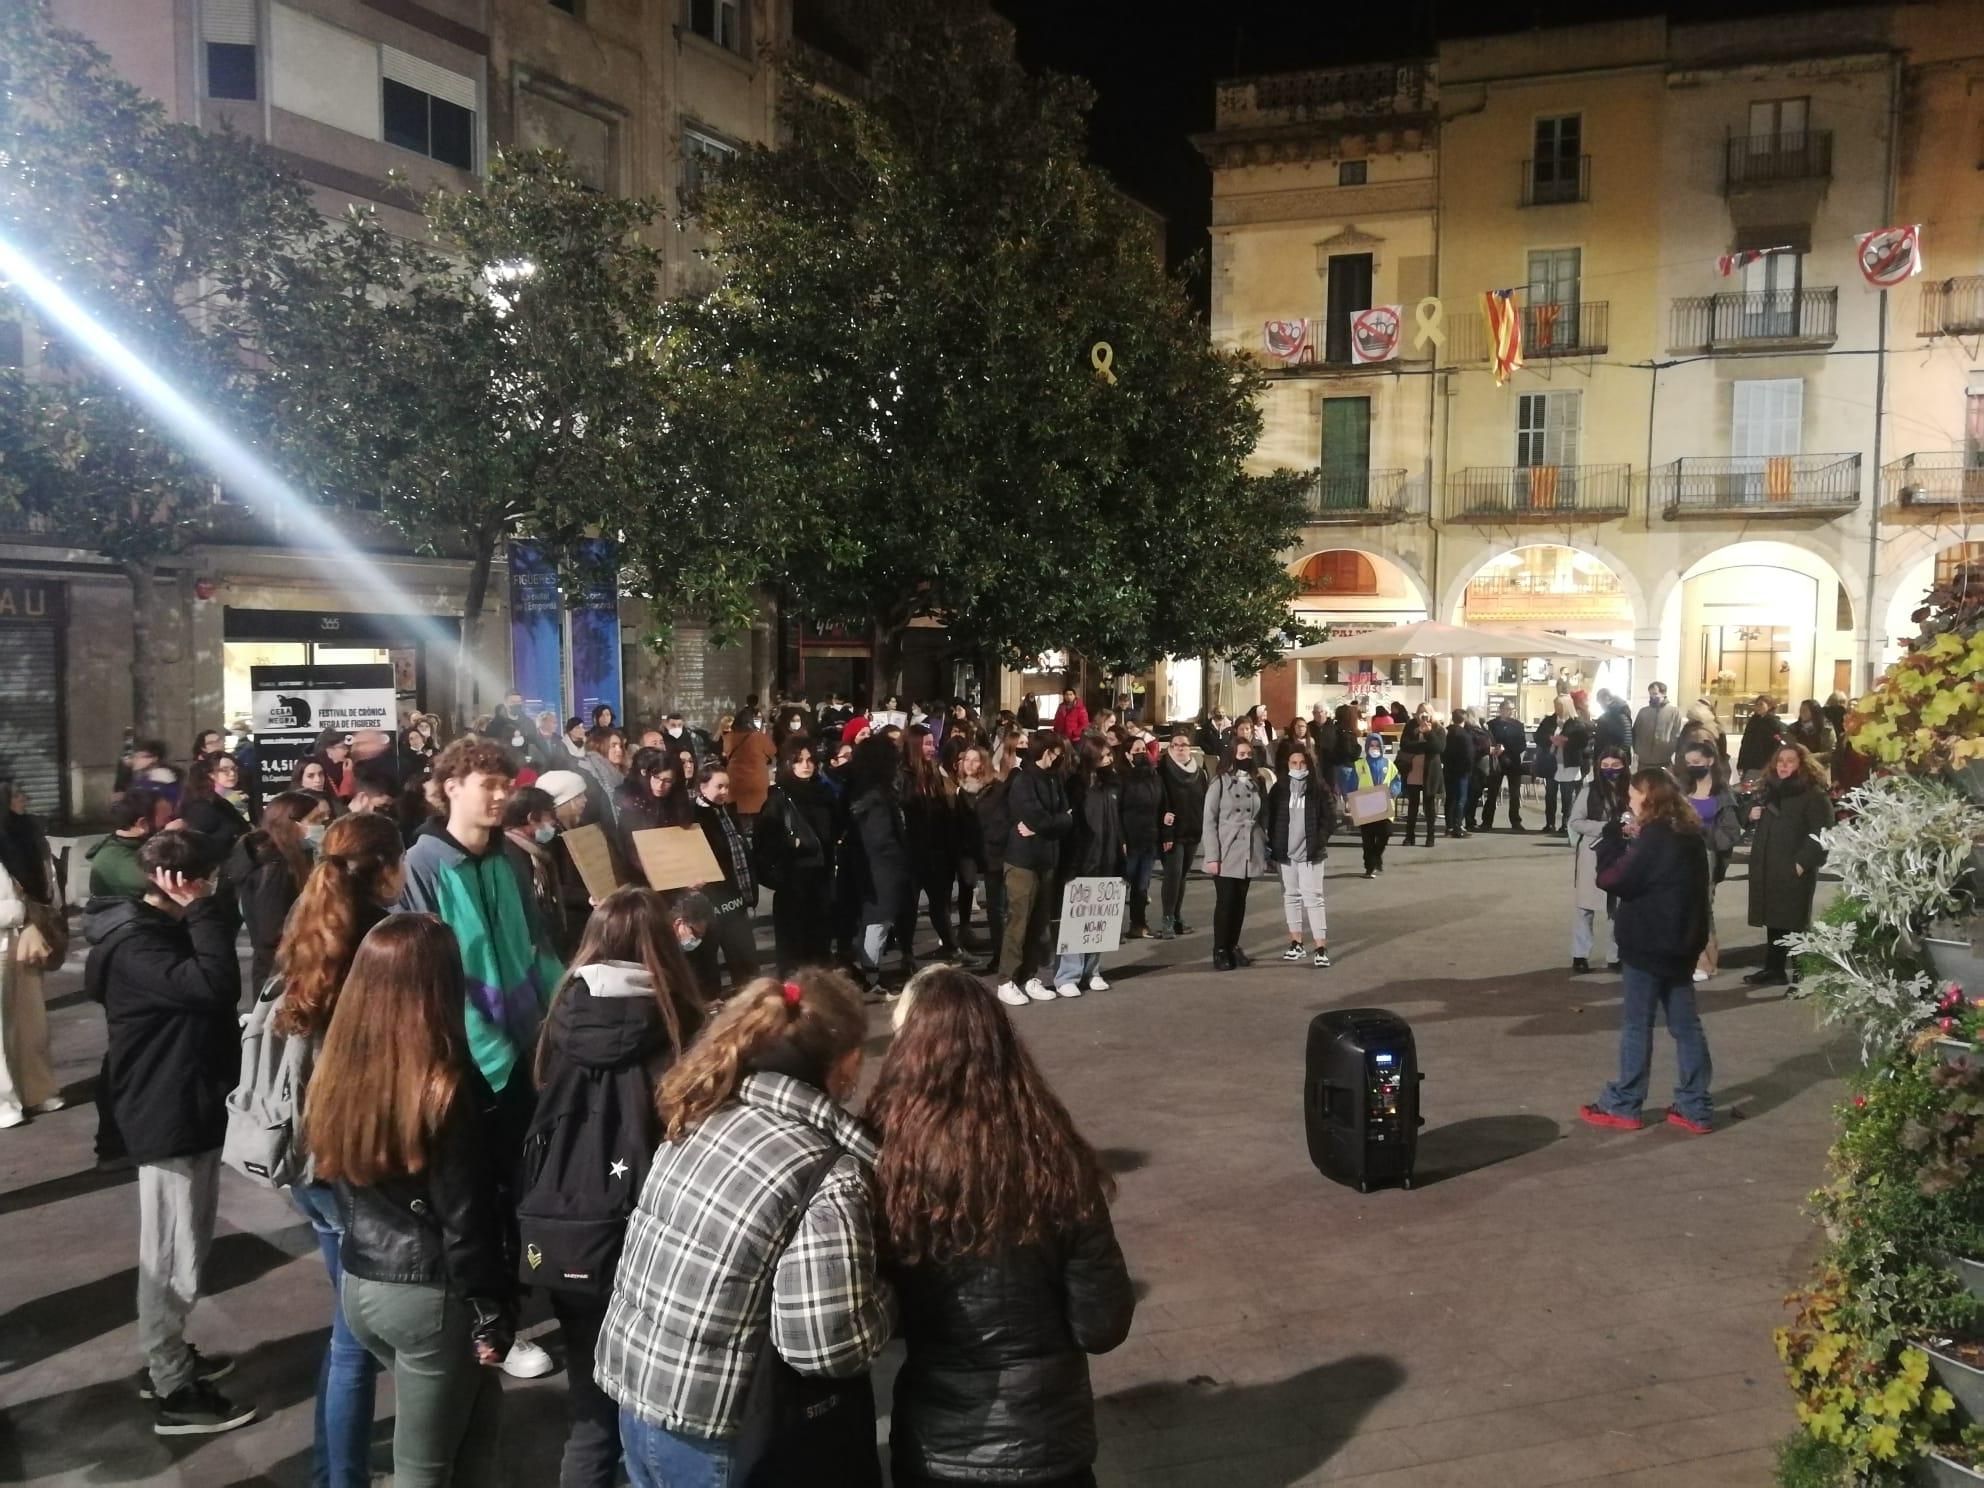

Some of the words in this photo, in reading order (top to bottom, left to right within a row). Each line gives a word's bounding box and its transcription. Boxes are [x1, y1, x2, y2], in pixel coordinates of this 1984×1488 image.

[513, 573, 556, 585] FIGUERES
[320, 617, 341, 630] 365
[270, 708, 292, 716] CEBA
[318, 708, 347, 717] FESTIVAL
[349, 708, 357, 717] DE
[268, 717, 296, 725] NEGRA
[319, 720, 341, 728] NEGRA
[341, 720, 350, 729] DE
[351, 719, 381, 728] FIGUERES
